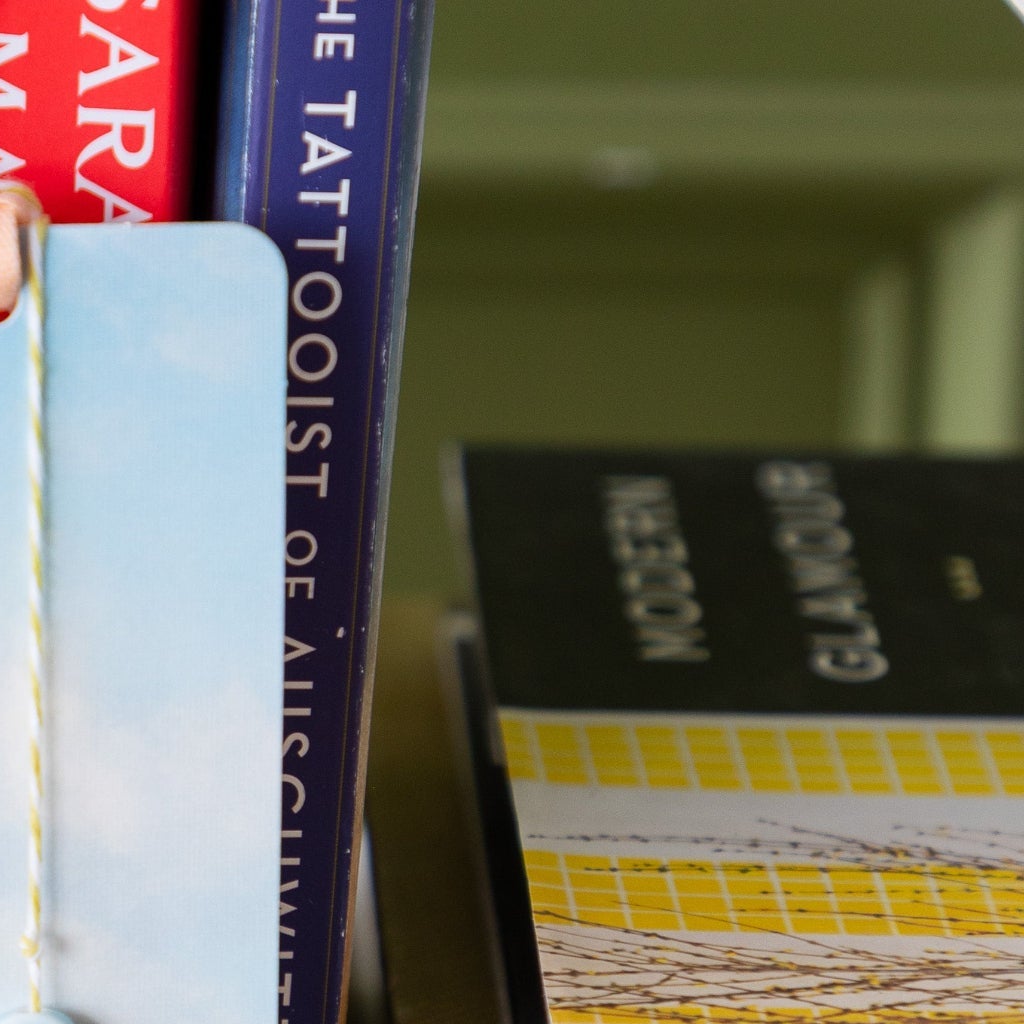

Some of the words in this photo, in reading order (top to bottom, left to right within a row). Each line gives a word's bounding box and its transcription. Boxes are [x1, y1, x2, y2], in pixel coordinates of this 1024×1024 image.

[74, 0, 160, 222] ARA
[286, 91, 357, 498] TATTOOIST
[285, 530, 319, 600] OF
[603, 475, 711, 662] MODERN
[757, 461, 889, 683] GLAMOUR
